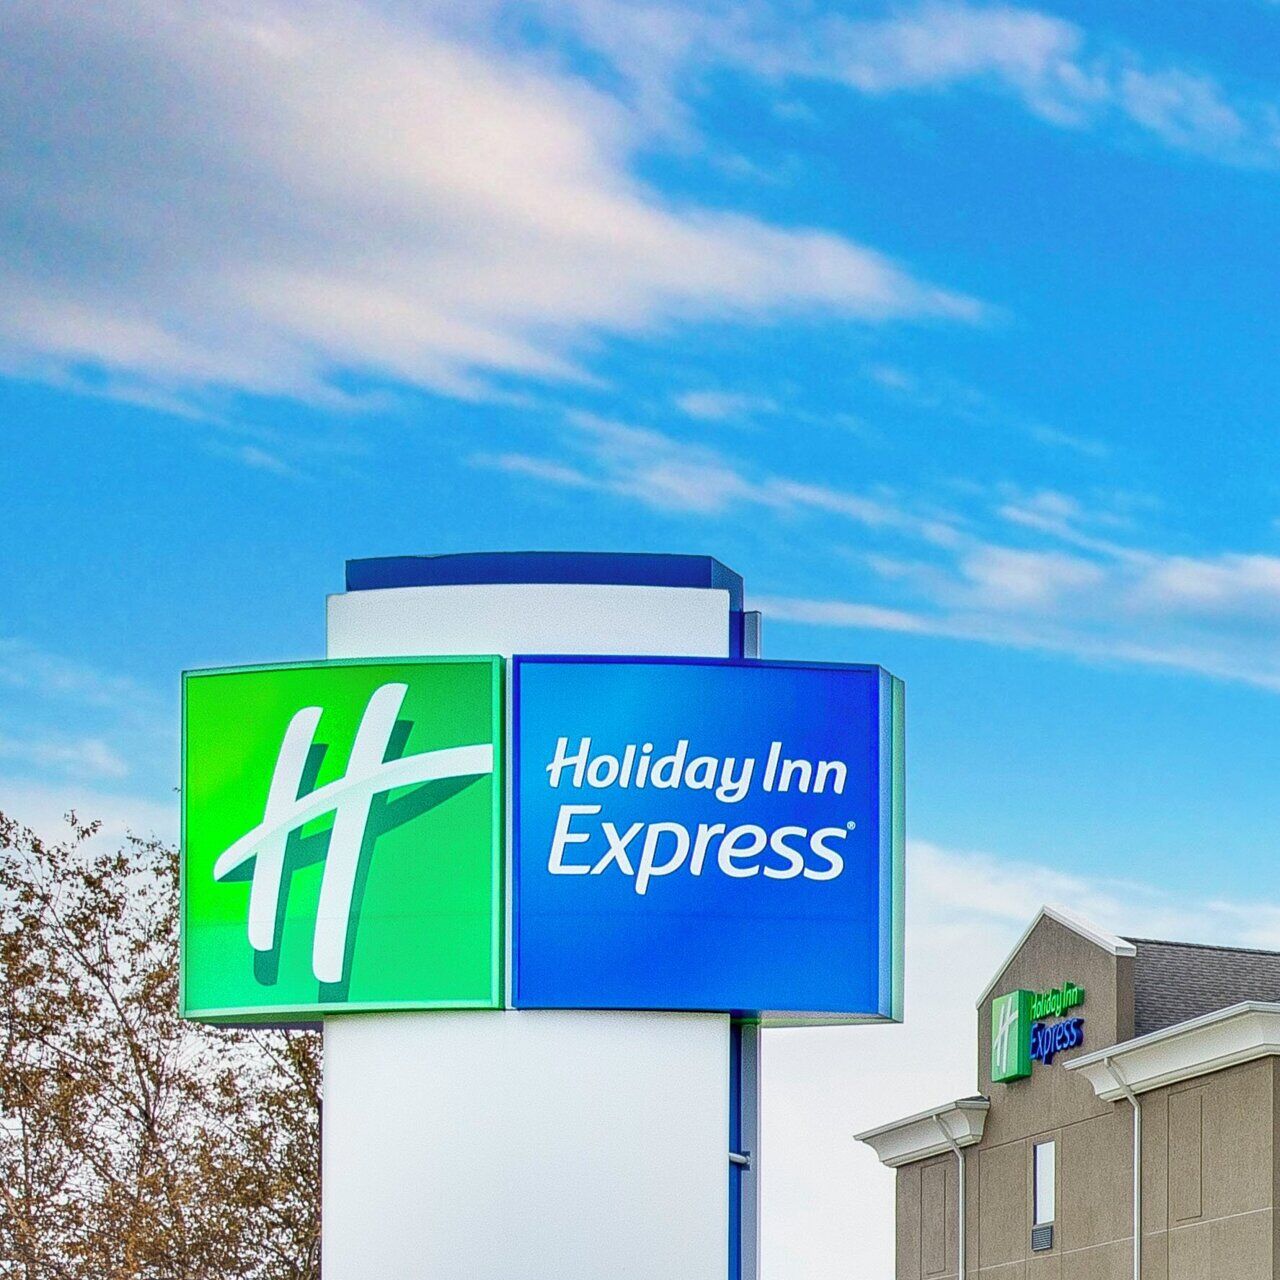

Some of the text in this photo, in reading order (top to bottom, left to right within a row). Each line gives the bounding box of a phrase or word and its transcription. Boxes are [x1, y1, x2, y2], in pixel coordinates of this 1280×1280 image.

[545, 736, 848, 804] Holiday Inn
[1029, 981, 1085, 1020] Holiday Inn
[1030, 1017, 1085, 1065] Express
